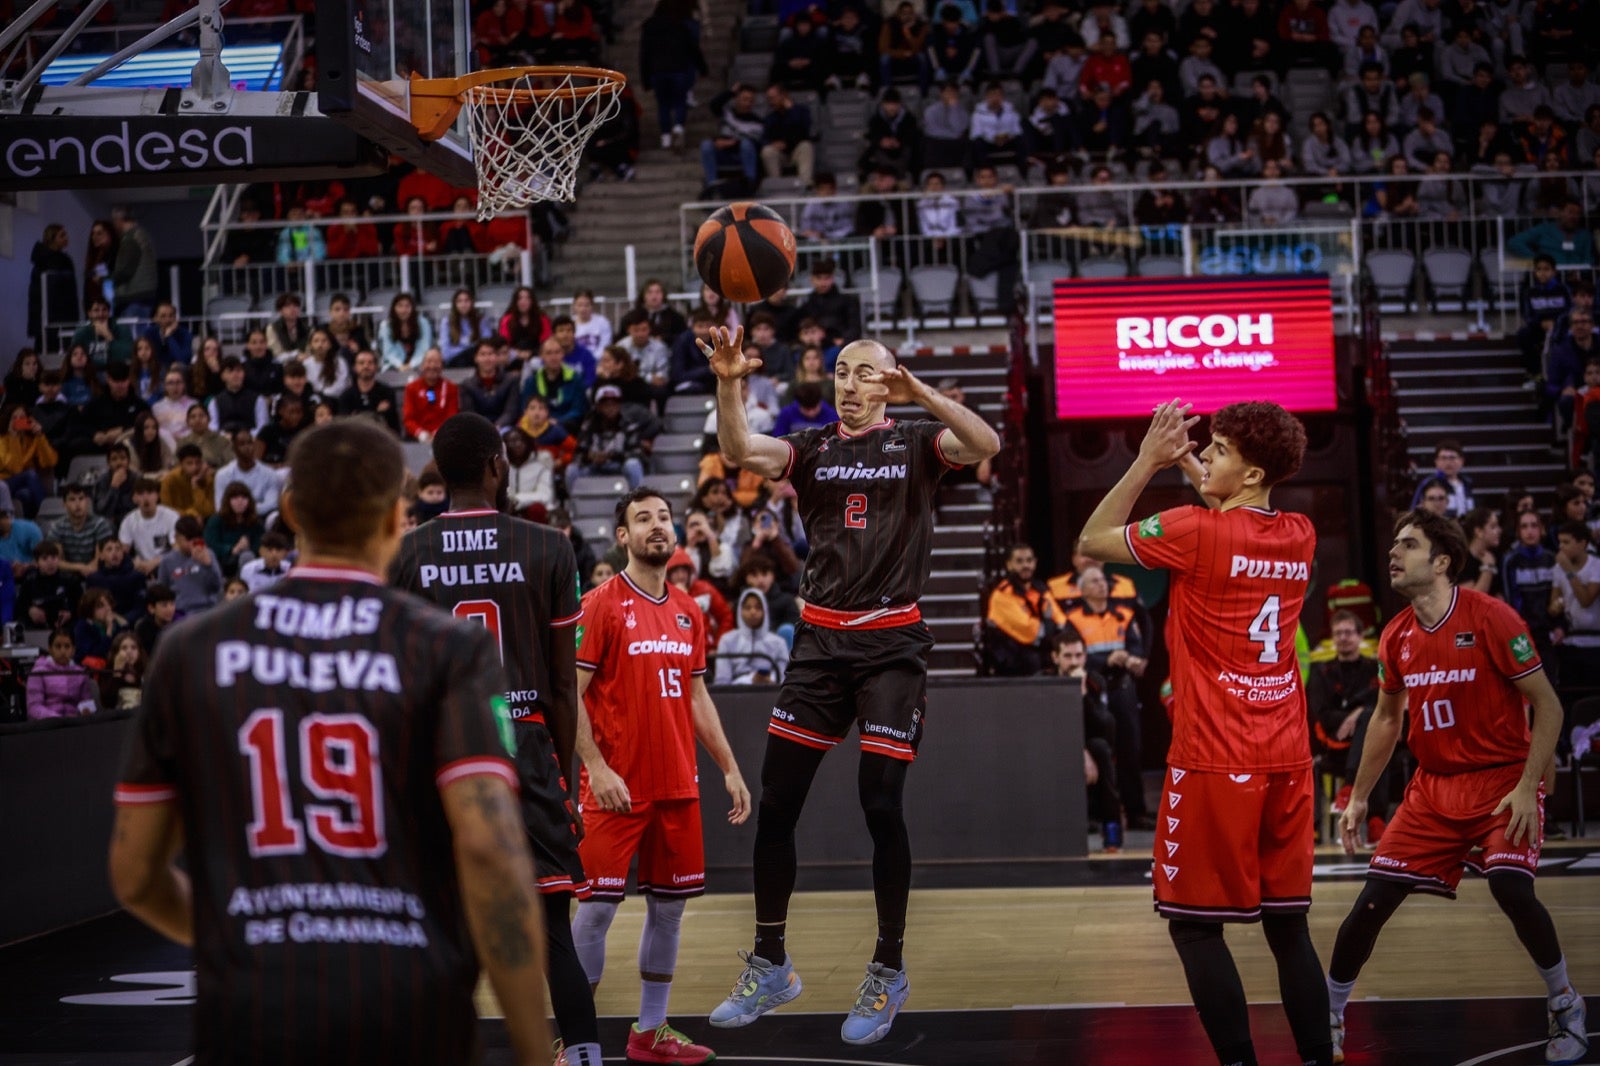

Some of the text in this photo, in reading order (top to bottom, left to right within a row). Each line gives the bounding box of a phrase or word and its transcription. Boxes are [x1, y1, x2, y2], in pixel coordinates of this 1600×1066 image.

[6, 121, 253, 177] endesa
[1116, 313, 1274, 349] RICOH
[844, 493, 868, 529] 2
[441, 528, 499, 553] DIME
[420, 562, 525, 588] PULEVA
[1230, 554, 1308, 581] PULEVA
[1248, 595, 1281, 663] 4
[215, 640, 402, 694] PULEVA
[658, 668, 682, 698] 15
[870, 723, 907, 740] BERNER
[1421, 699, 1456, 732] 10
[238, 708, 388, 858] 19
[227, 883, 426, 920] AYUNTAMIENTO
[245, 911, 430, 948] DE GRANADA
